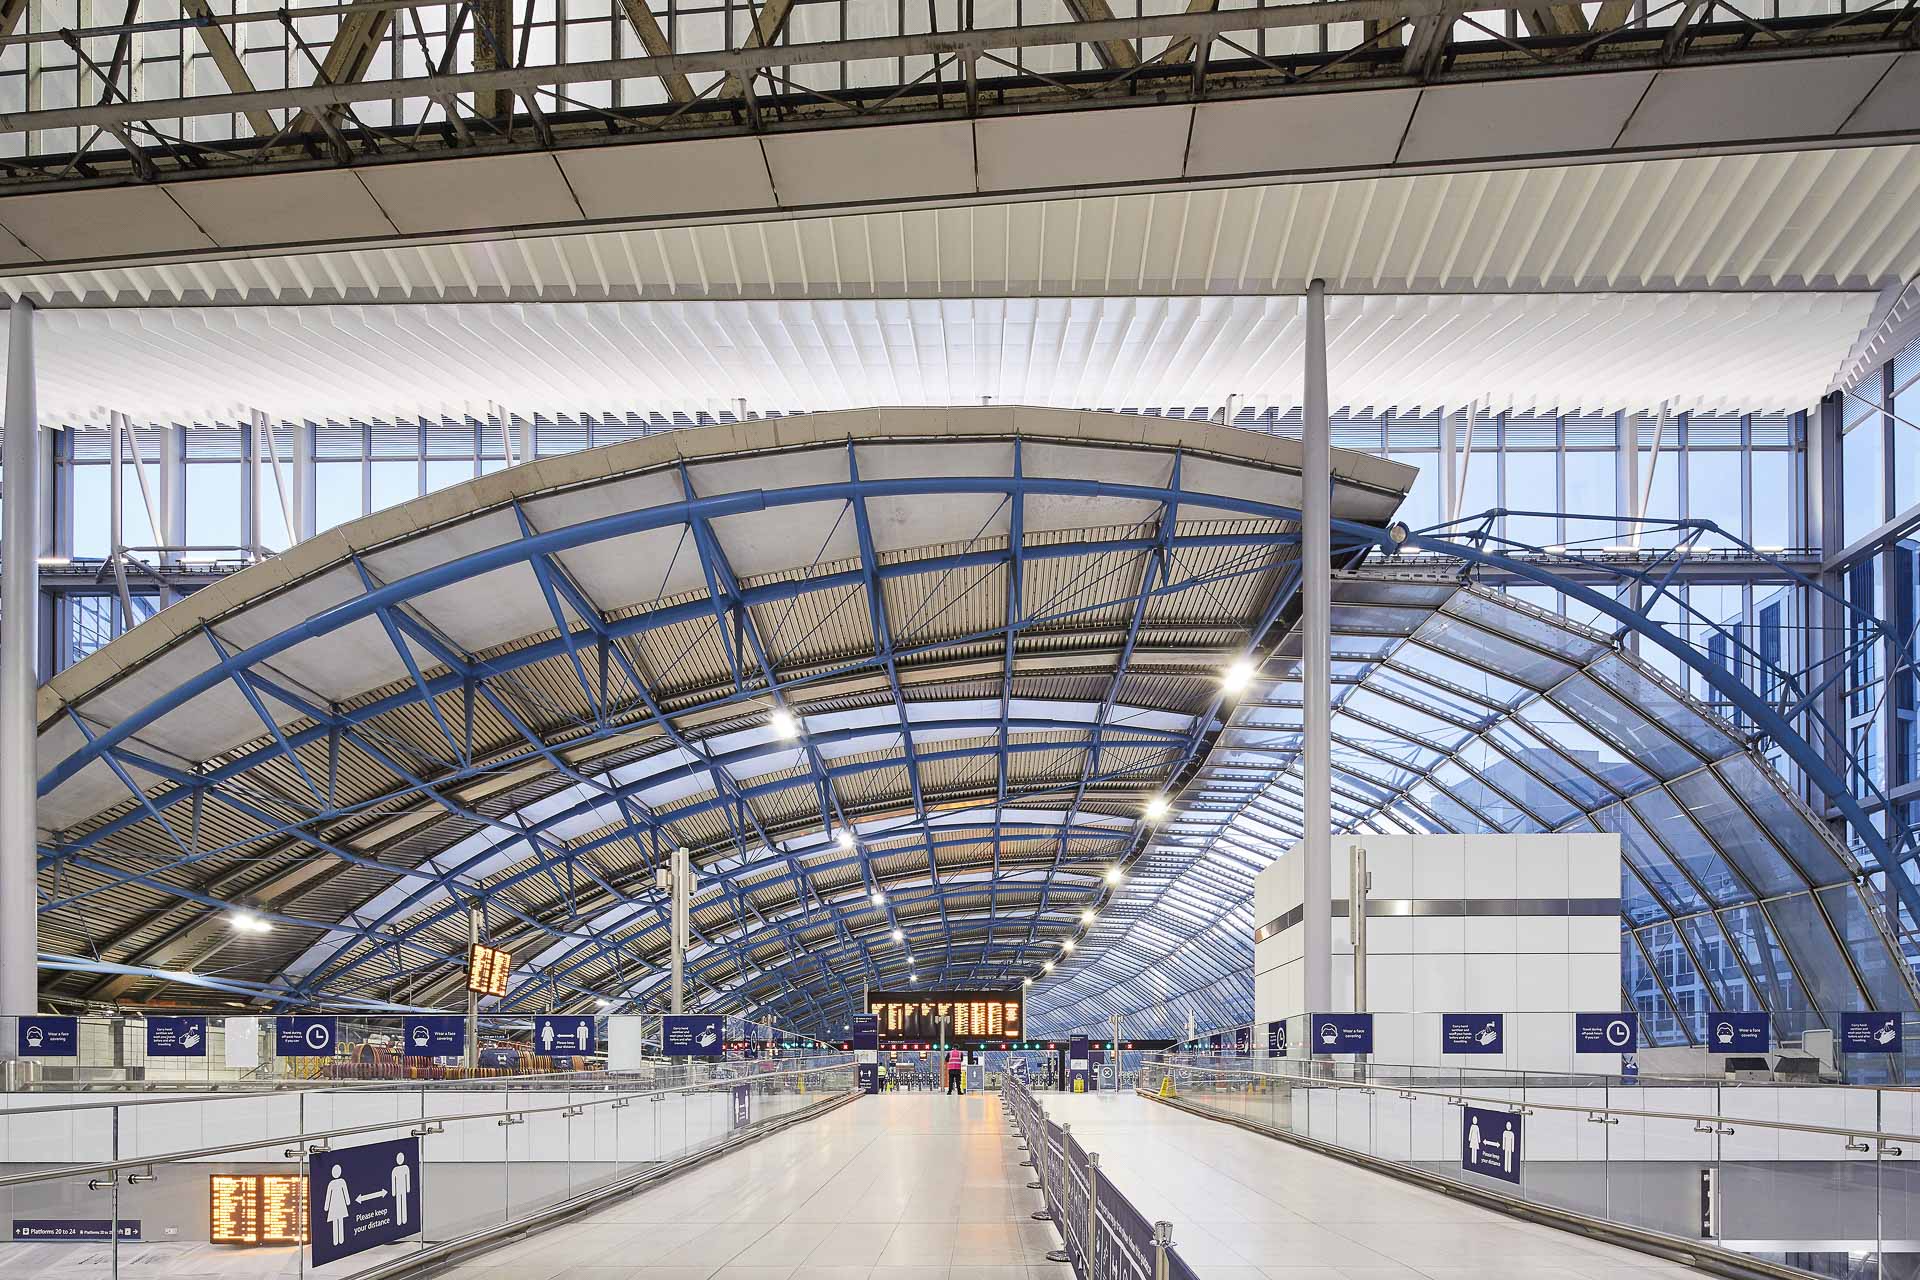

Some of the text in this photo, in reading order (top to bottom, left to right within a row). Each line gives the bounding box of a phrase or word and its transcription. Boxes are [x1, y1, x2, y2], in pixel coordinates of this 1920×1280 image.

[356, 1208, 388, 1222] Please keep
[354, 1218, 390, 1236] your distance
